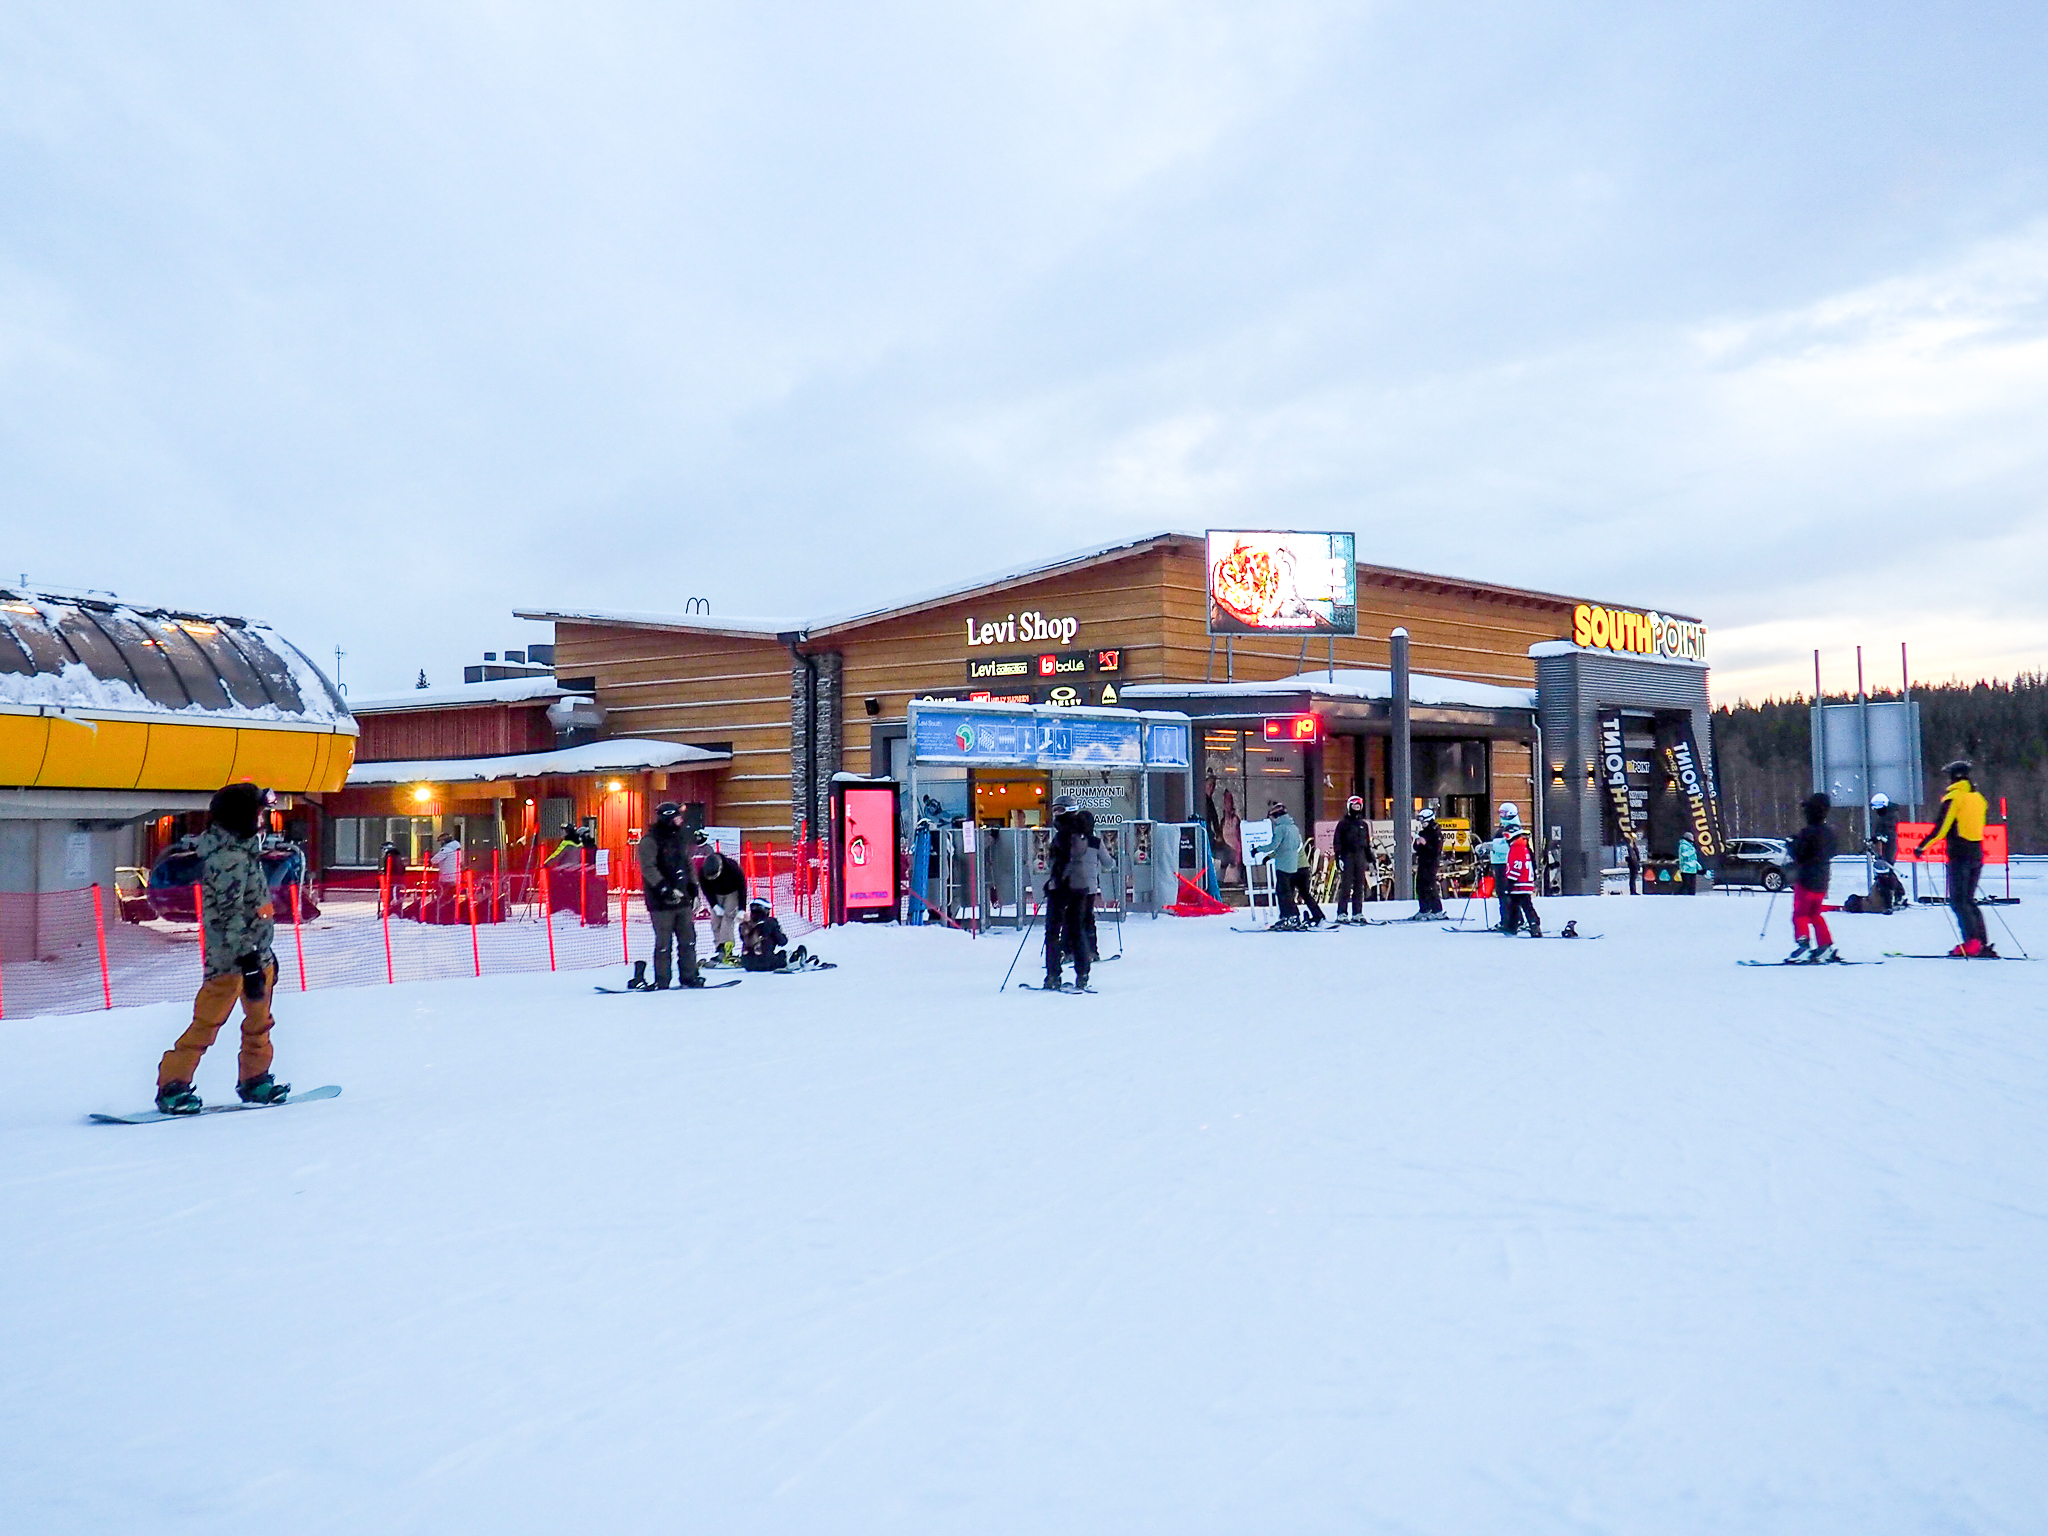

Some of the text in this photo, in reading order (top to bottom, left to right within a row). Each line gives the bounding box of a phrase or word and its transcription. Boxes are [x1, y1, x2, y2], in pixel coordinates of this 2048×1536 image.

[966, 611, 1078, 646] Levi Shop
[971, 660, 996, 678] Levi
[1055, 659, 1085, 673] bollé
[1045, 698, 1082, 707] OAKLEY
[1061, 786, 1124, 797] LIPUNMYYNTI
[1076, 798, 1111, 808] PASSES
[1094, 814, 1123, 824] AAMO
[1513, 860, 1523, 870] 20
